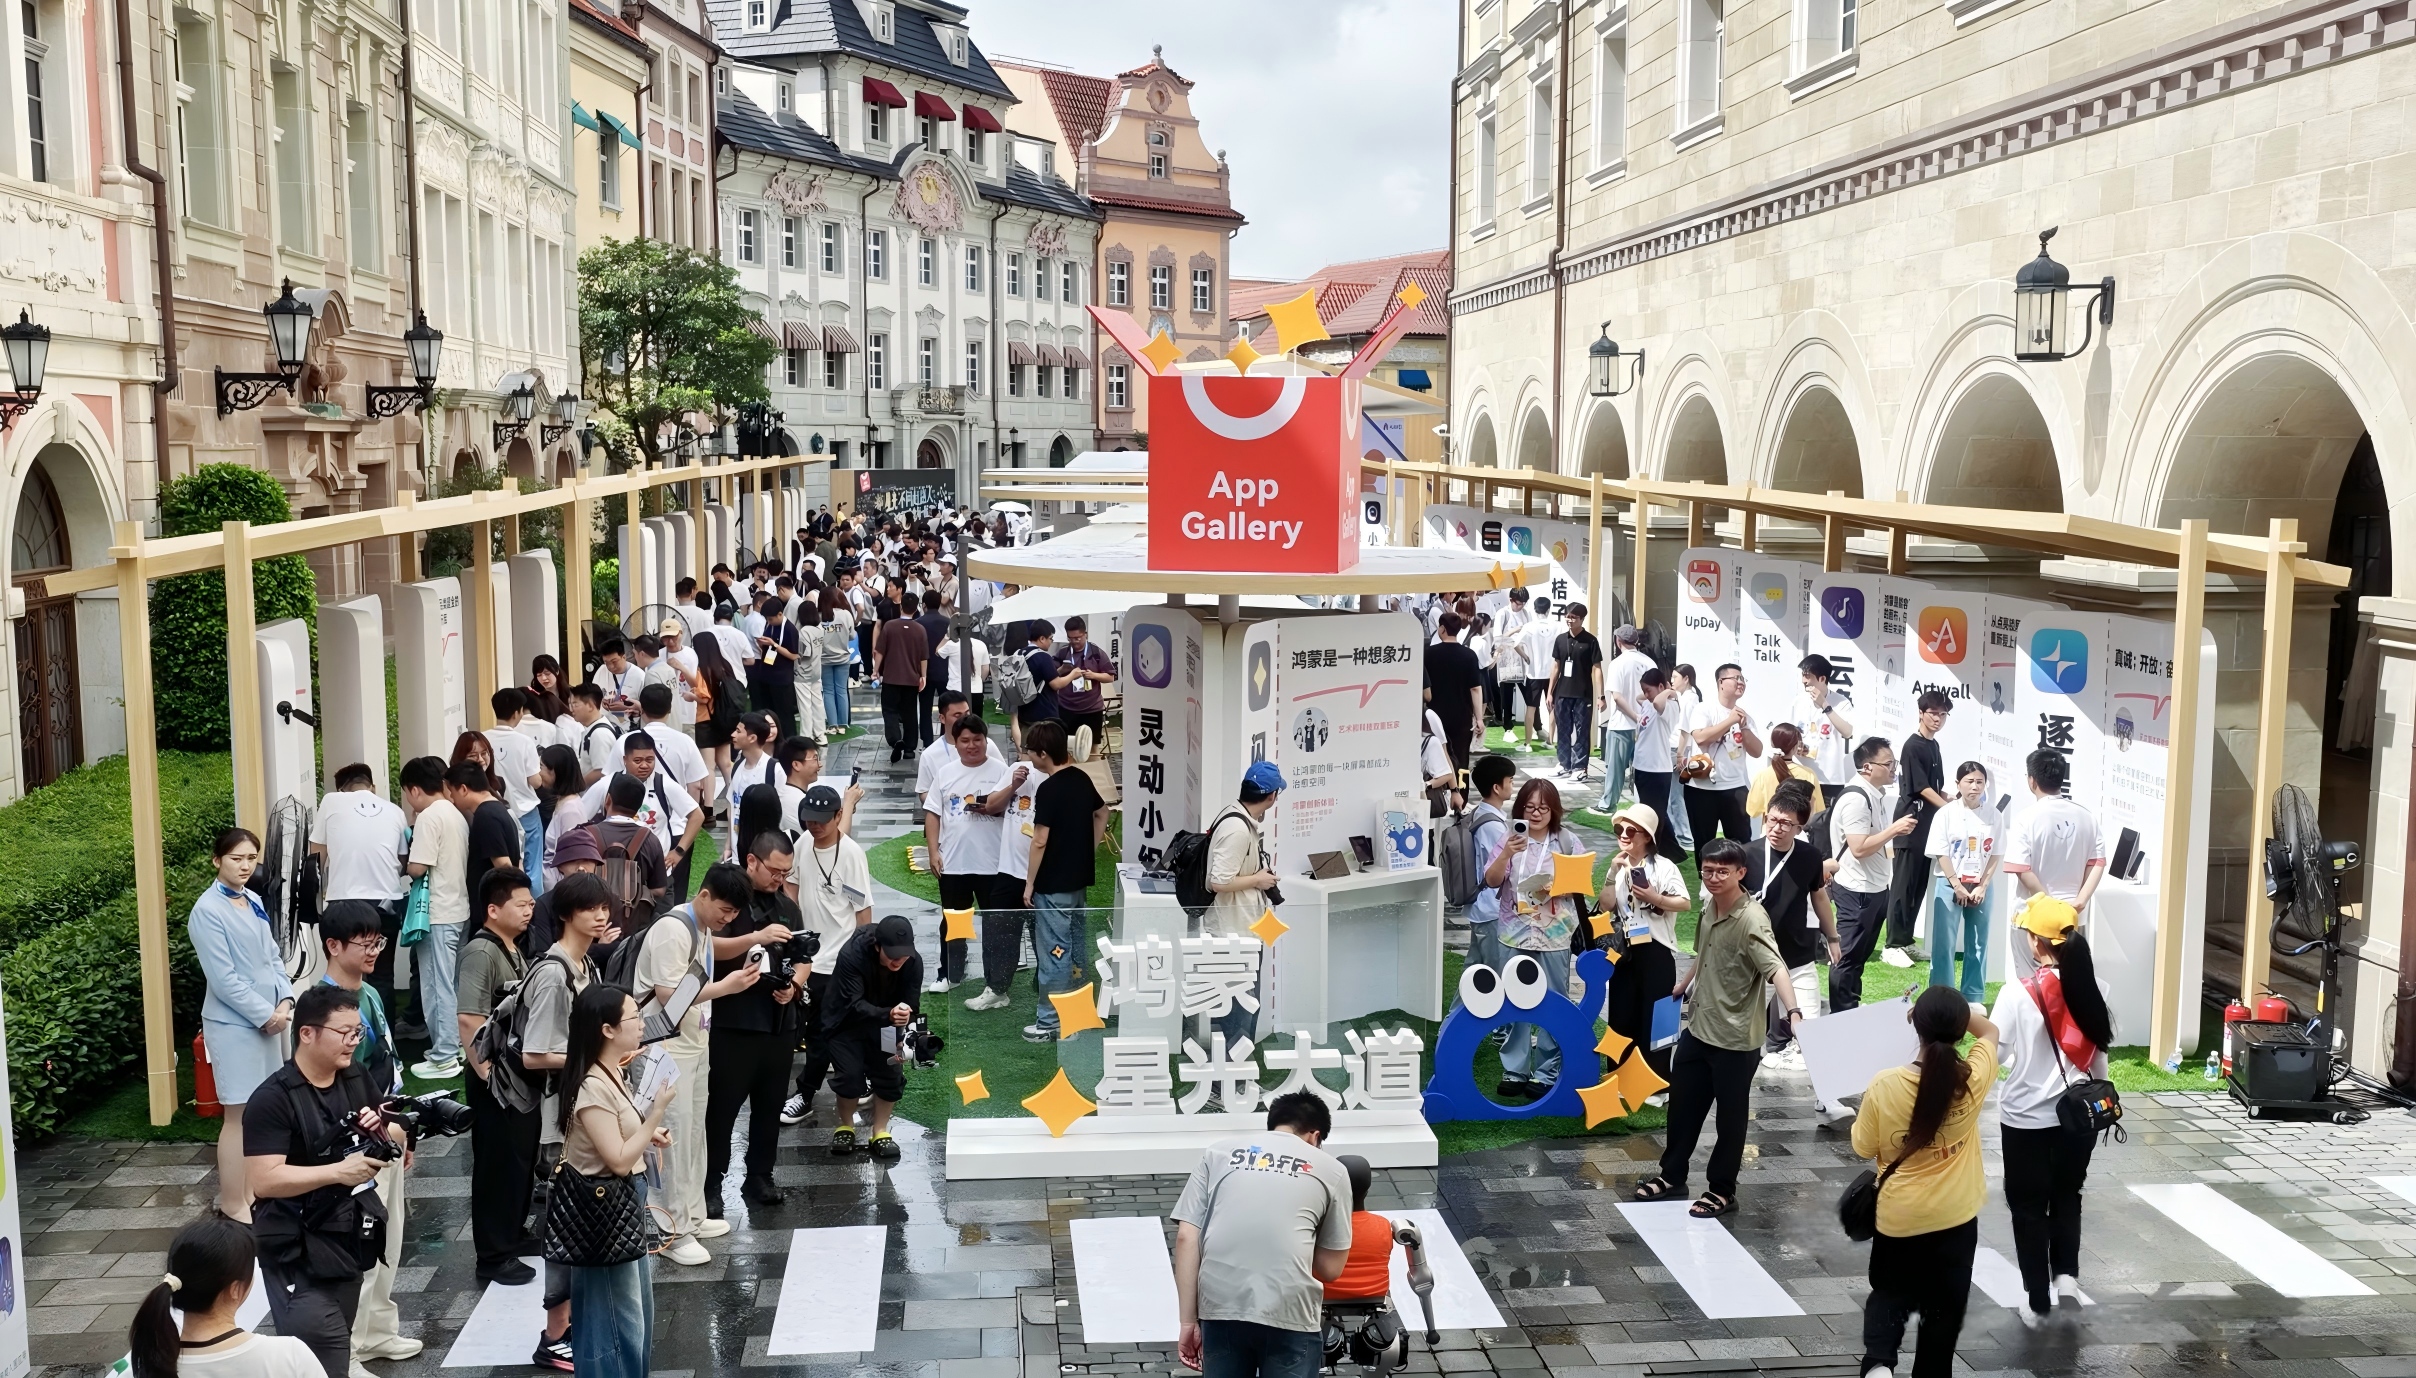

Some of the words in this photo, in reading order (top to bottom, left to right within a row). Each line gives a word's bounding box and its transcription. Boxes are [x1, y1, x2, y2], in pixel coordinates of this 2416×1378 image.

[1207, 470, 1280, 507] App
[1181, 511, 1304, 549] Gallery
[1685, 615, 1721, 632] UpDay
[1754, 633, 1781, 648] Talk
[1291, 644, 1411, 670] 鸿蒙是一种想象力
[1754, 649, 1781, 664] Talk
[1911, 680, 1971, 700] Artwall
[1094, 932, 1262, 1019] 鸿蒙
[1094, 1026, 1425, 1116] 星光大道
[1229, 1147, 1312, 1178] STAFF
